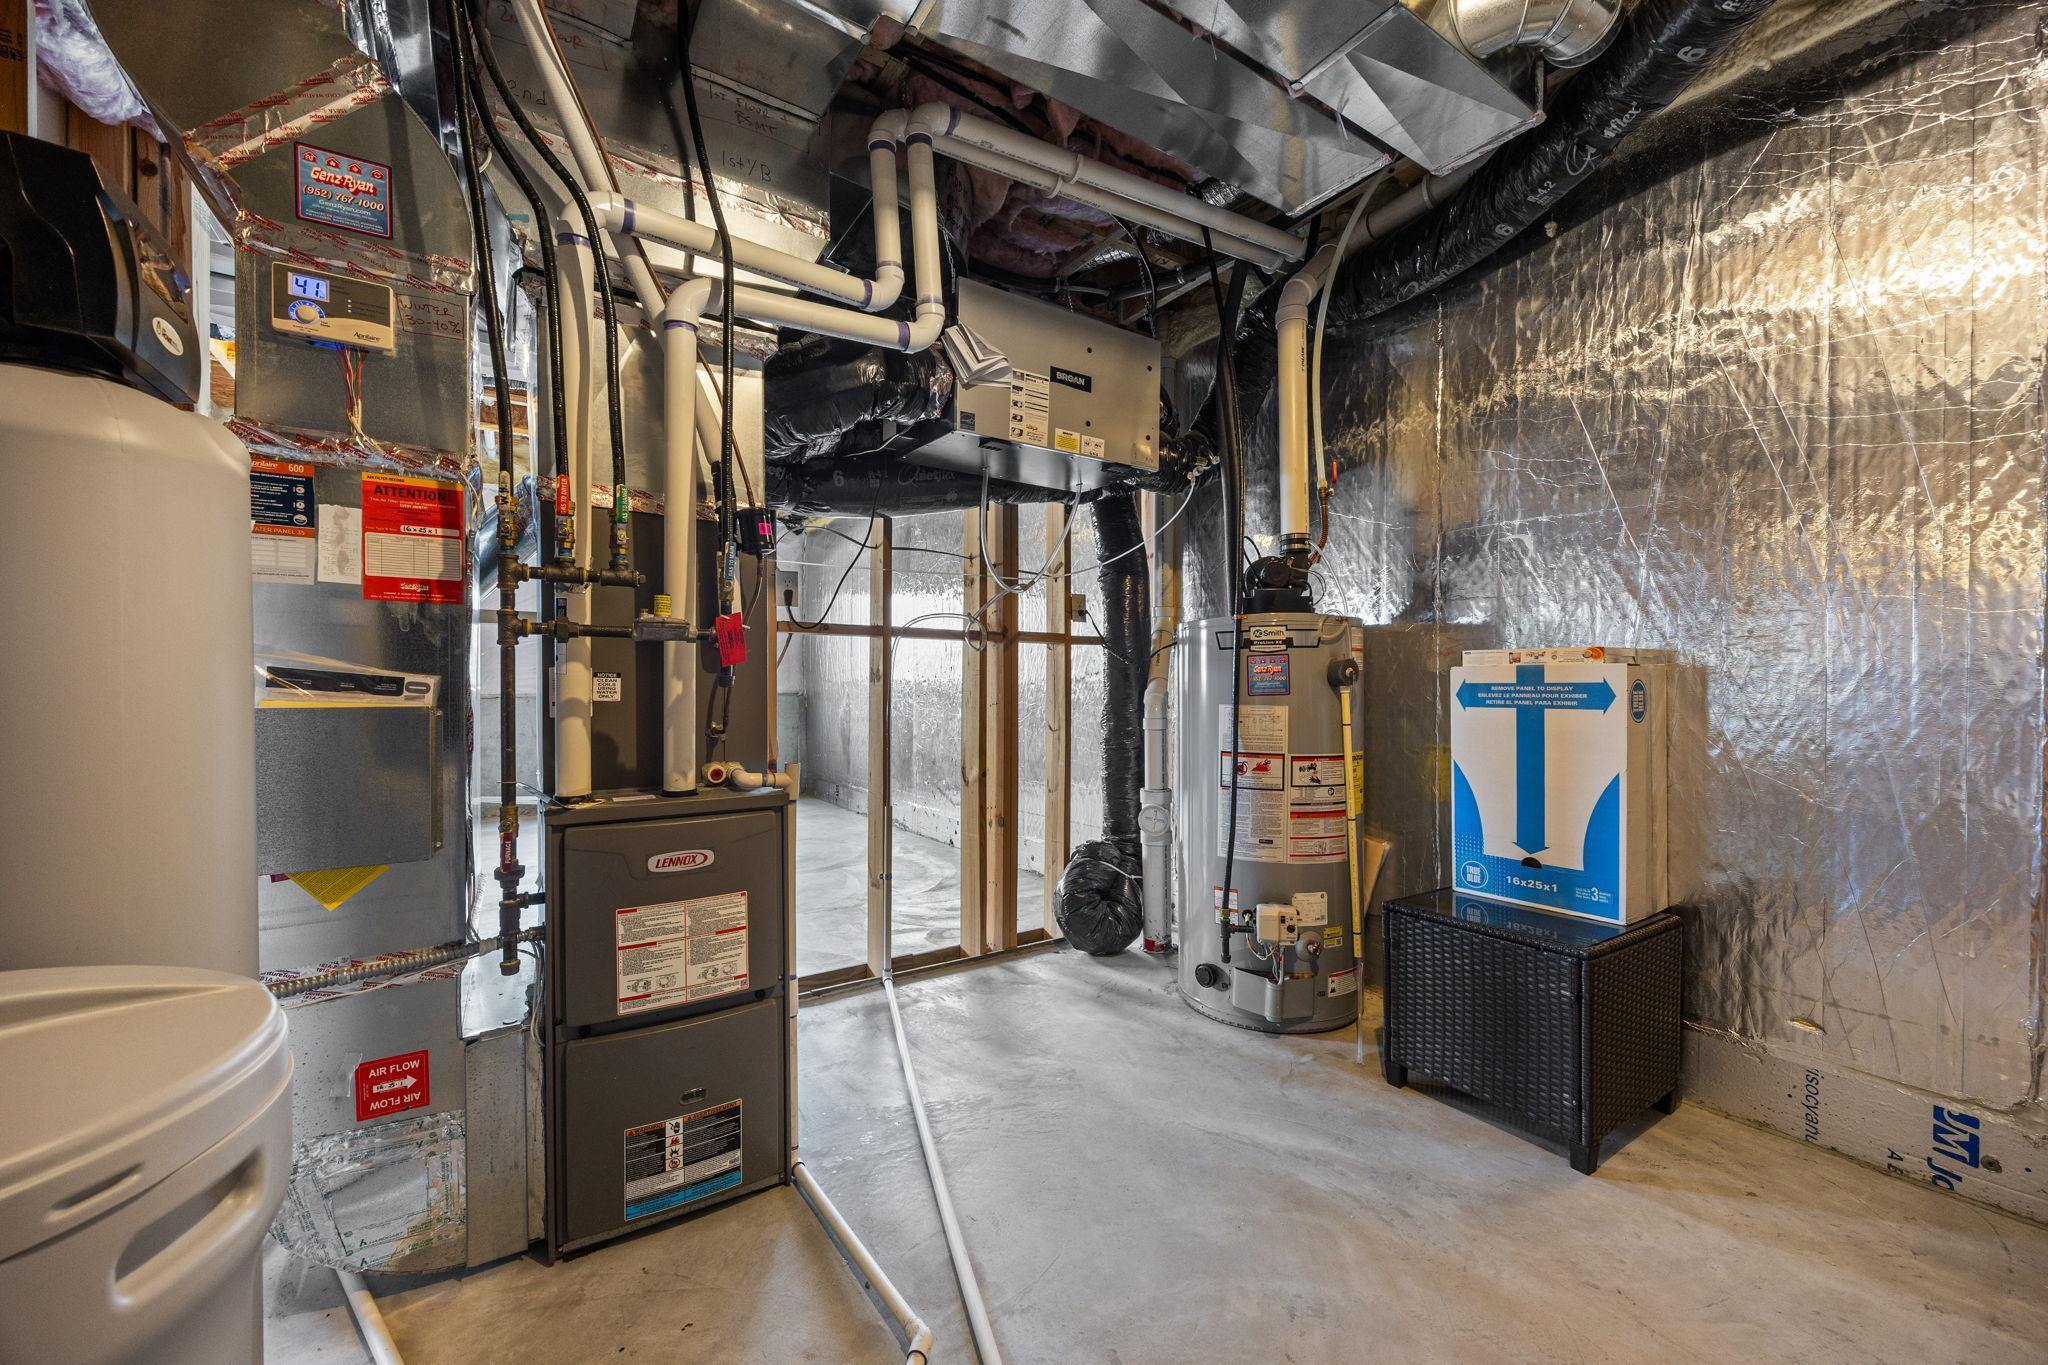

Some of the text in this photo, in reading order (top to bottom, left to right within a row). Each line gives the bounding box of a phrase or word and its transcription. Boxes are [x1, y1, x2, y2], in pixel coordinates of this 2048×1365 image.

[1677, 45, 1707, 62] 6
[302, 184, 332, 200] (952)
[295, 277, 320, 298] 41
[405, 314, 462, 334] 30-40%
[353, 331, 381, 342] Aprilaire
[1056, 371, 1085, 386] BROAN
[251, 460, 304, 473] prilaire 600
[254, 525, 272, 534] ATER
[273, 527, 295, 535] PANEL
[655, 854, 698, 869] LENNOX
[1466, 865, 1481, 876] TRUE
[1466, 873, 1481, 884] BLUE
[1505, 875, 1558, 893] 16x25x1
[1591, 887, 1598, 901] 3
[368, 1060, 420, 1078] AIR FLOW
[370, 1092, 421, 1111] AIR FLOW
